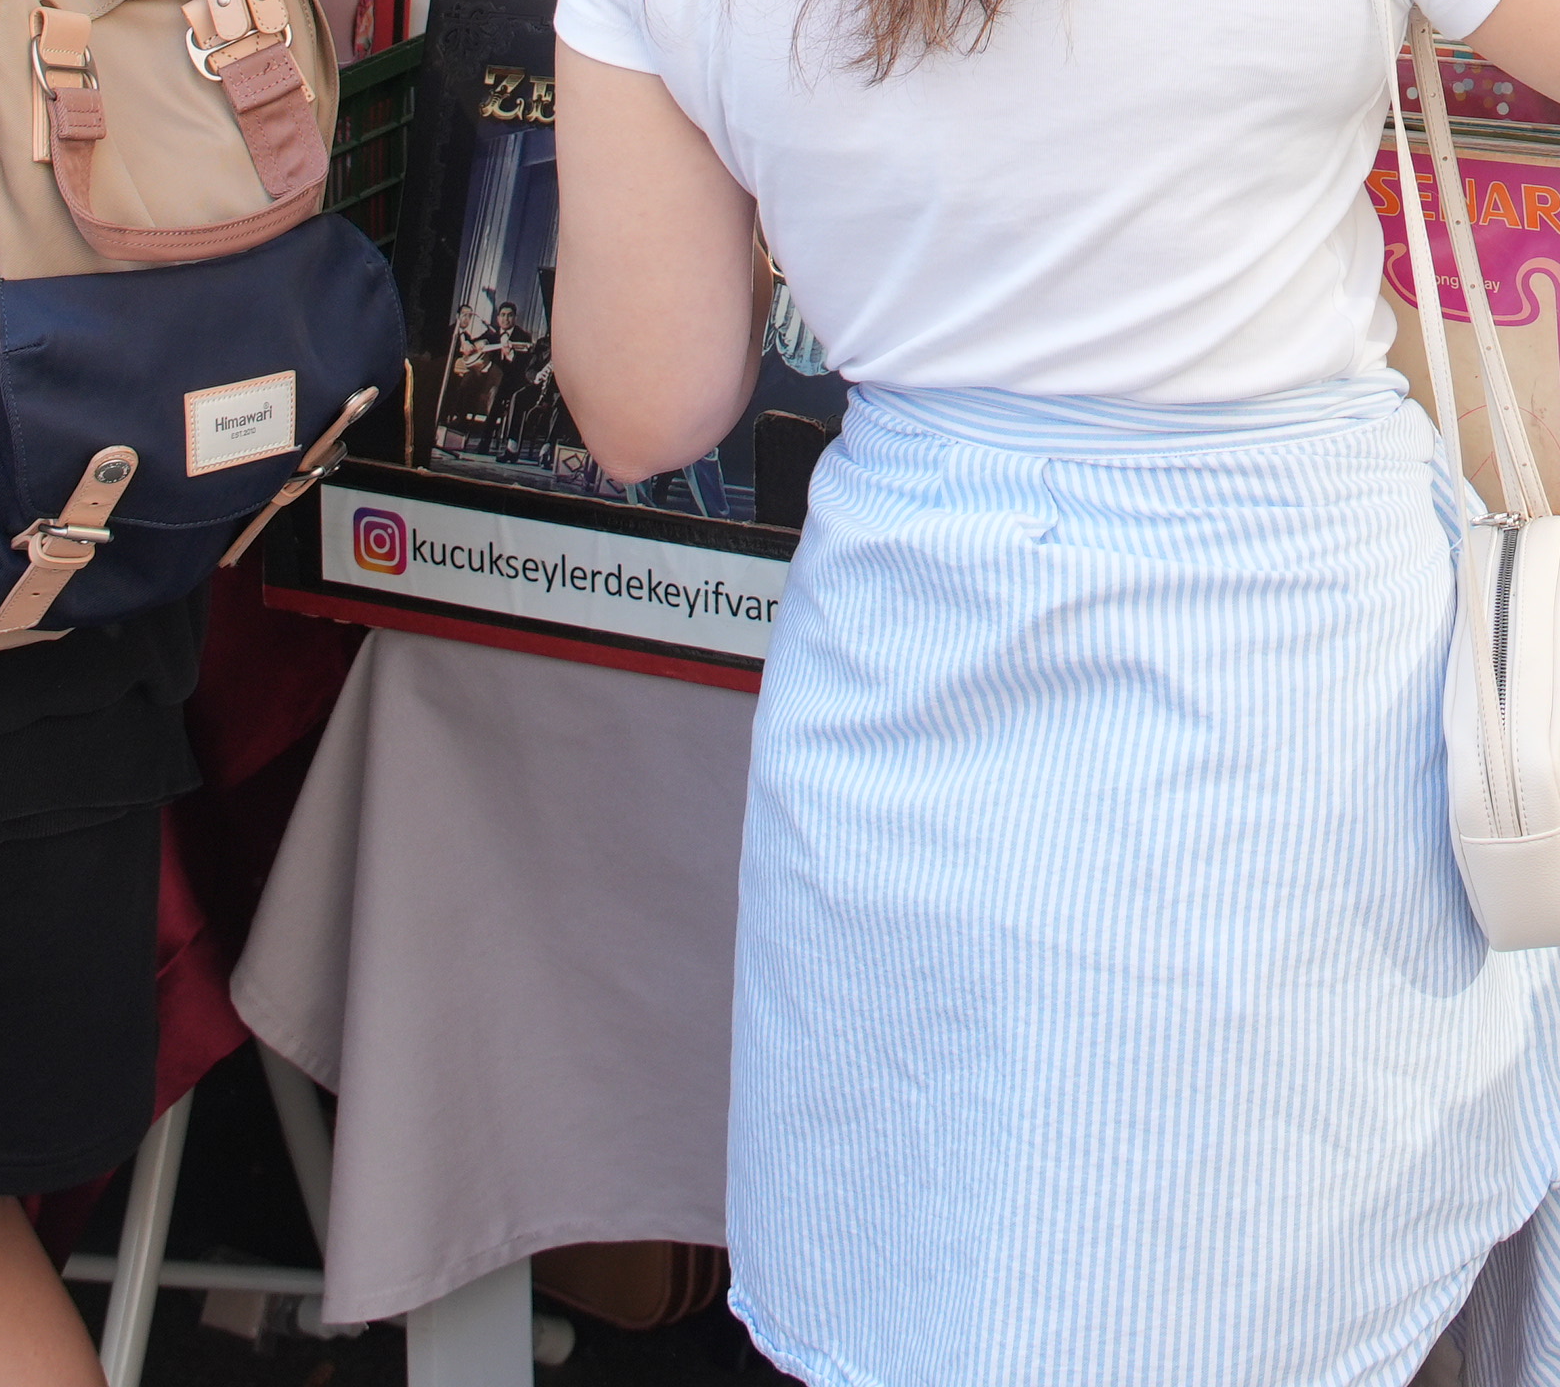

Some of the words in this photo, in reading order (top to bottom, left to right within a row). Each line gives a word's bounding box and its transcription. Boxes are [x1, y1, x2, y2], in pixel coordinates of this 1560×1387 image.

[480, 64, 555, 123] ZE
[1435, 275, 1459, 290] ong
[215, 405, 273, 433] Himawari
[411, 528, 779, 623] kucukseylerdekeyifvar
